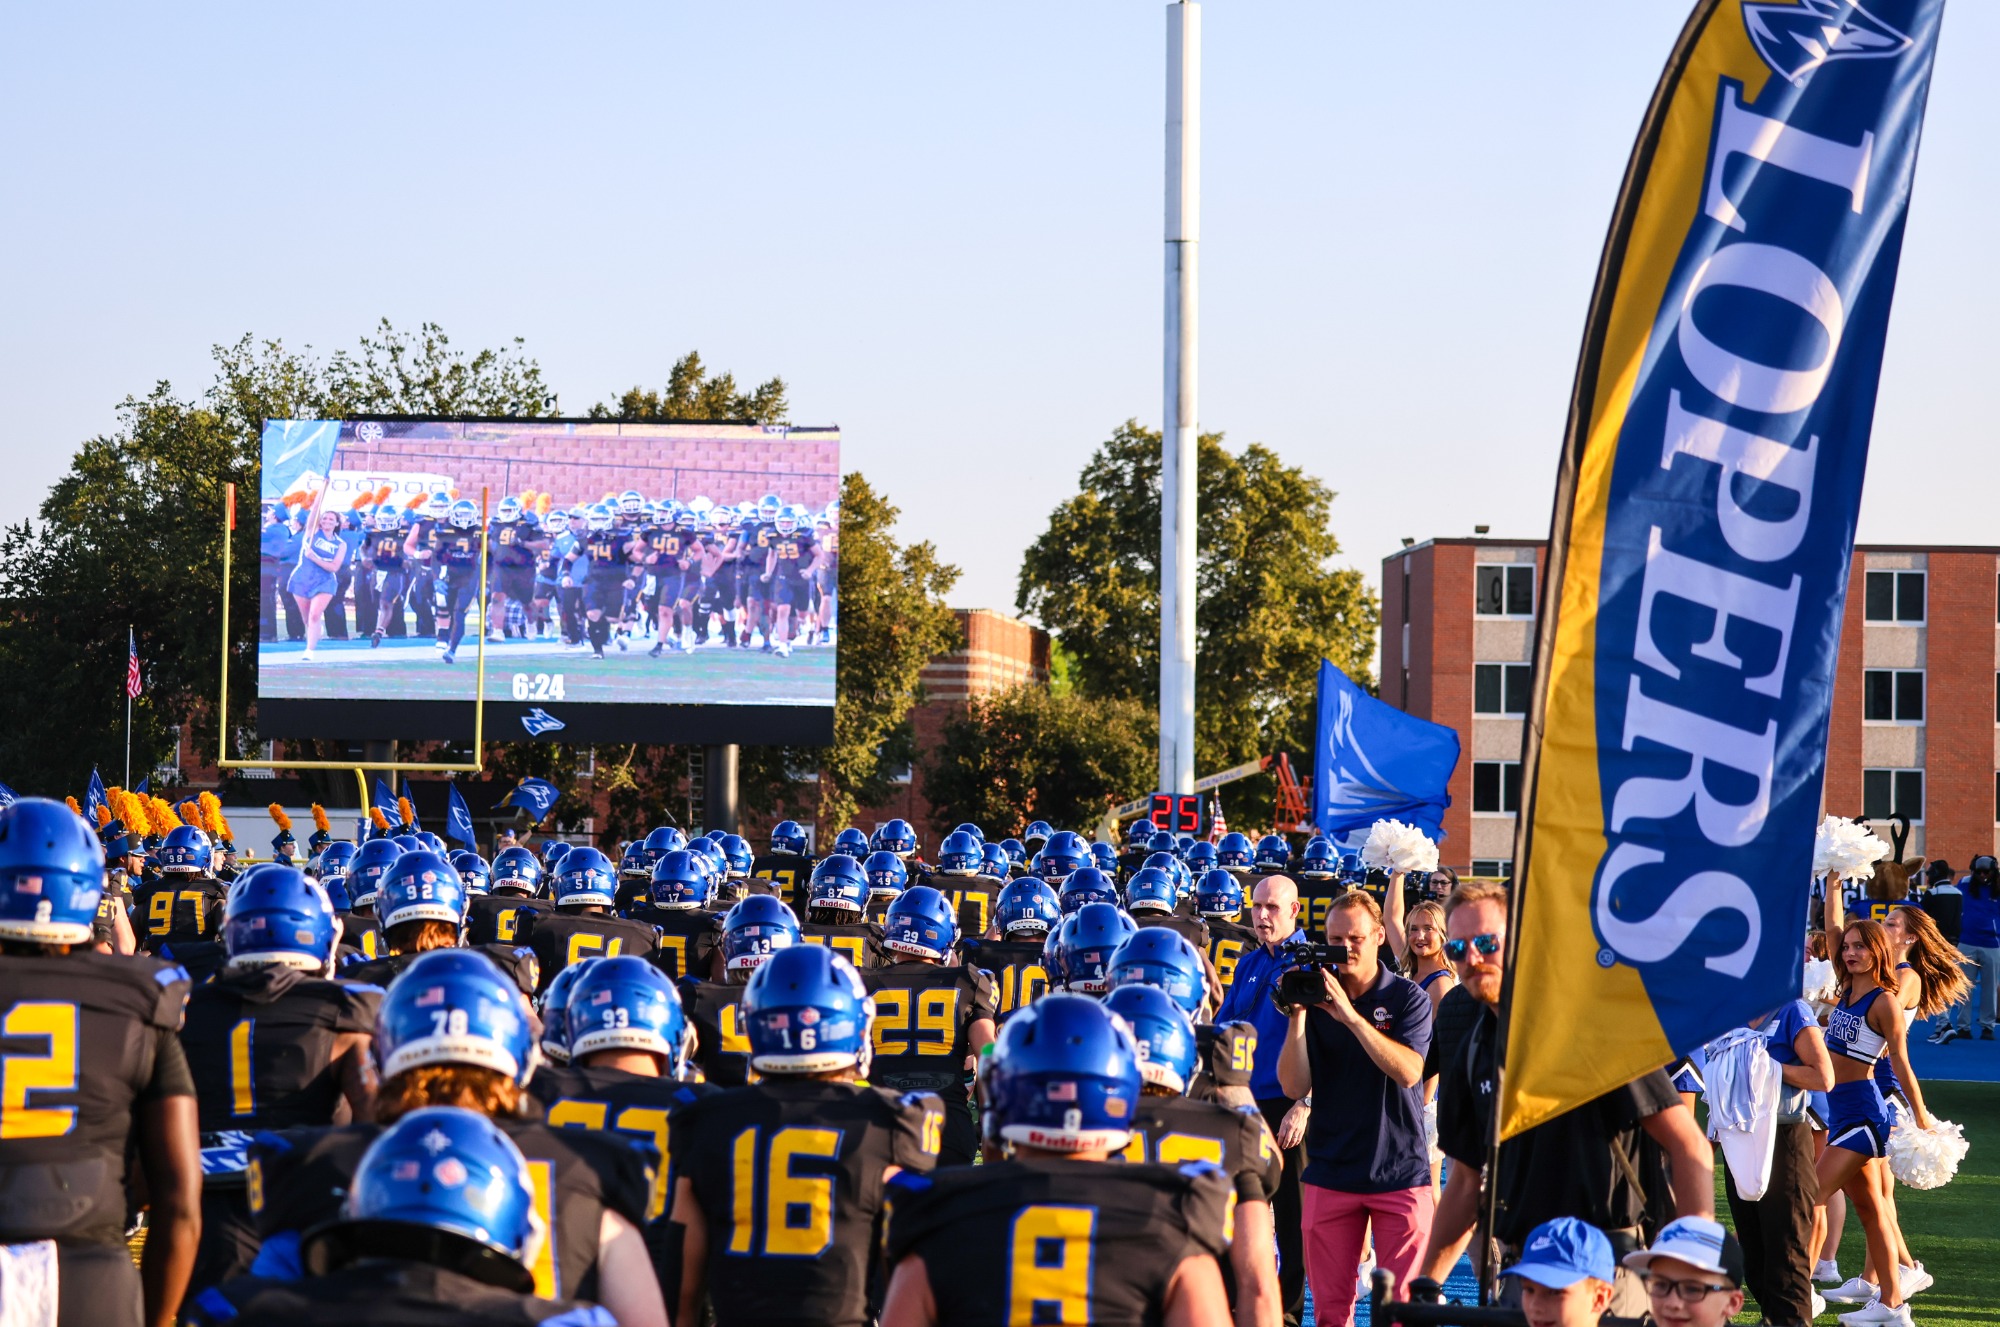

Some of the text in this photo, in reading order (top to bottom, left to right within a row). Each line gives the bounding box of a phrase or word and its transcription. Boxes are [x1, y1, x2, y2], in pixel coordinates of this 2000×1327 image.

[1597, 85, 1874, 979] LOPERS
[377, 540, 397, 557] 14
[587, 544, 611, 561] 74
[652, 537, 680, 555] 40
[512, 672, 566, 700] 6:24
[1151, 795, 1199, 831] 25
[169, 854, 183, 863] 98
[333, 865, 347, 875] 90
[512, 869, 519, 879] 9
[1051, 866, 1058, 875] 6
[500, 879, 528, 889] Riddell
[575, 878, 592, 890] 51
[878, 877, 891, 886] 49
[406, 883, 433, 900] 92
[668, 893, 680, 903] 17
[828, 888, 844, 899] 87
[819, 899, 850, 909] Riddell
[148, 890, 206, 936] 97
[394, 911, 413, 920] TEAM
[1022, 907, 1034, 918] 10
[903, 930, 919, 944] 29
[751, 939, 770, 954] 43
[891, 942, 927, 956] Riddell
[602, 1007, 629, 1029] 93
[871, 987, 961, 1056] 29
[583, 1037, 606, 1047] TEAM
[780, 1028, 817, 1051] 16
[0, 999, 80, 1139] 2
[228, 1018, 256, 1117] 1
[725, 1124, 845, 1260] 16
